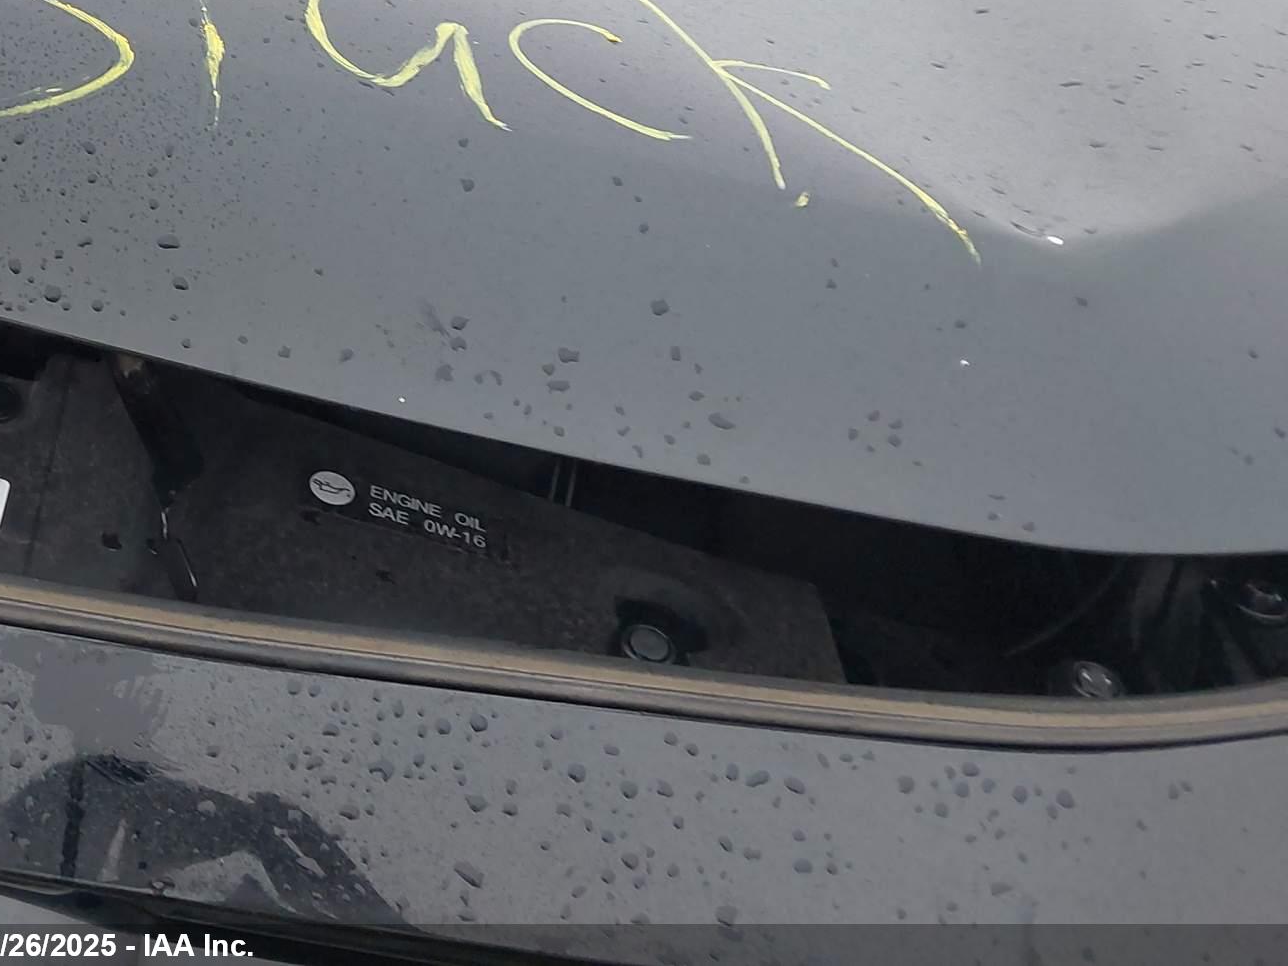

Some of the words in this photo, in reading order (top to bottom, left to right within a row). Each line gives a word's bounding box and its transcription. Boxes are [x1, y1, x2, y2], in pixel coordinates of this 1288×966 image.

[368, 502, 409, 525] SAE
[423, 519, 487, 548] 0W-16
[369, 485, 442, 518] ENGINE
[454, 512, 487, 532] OIL
